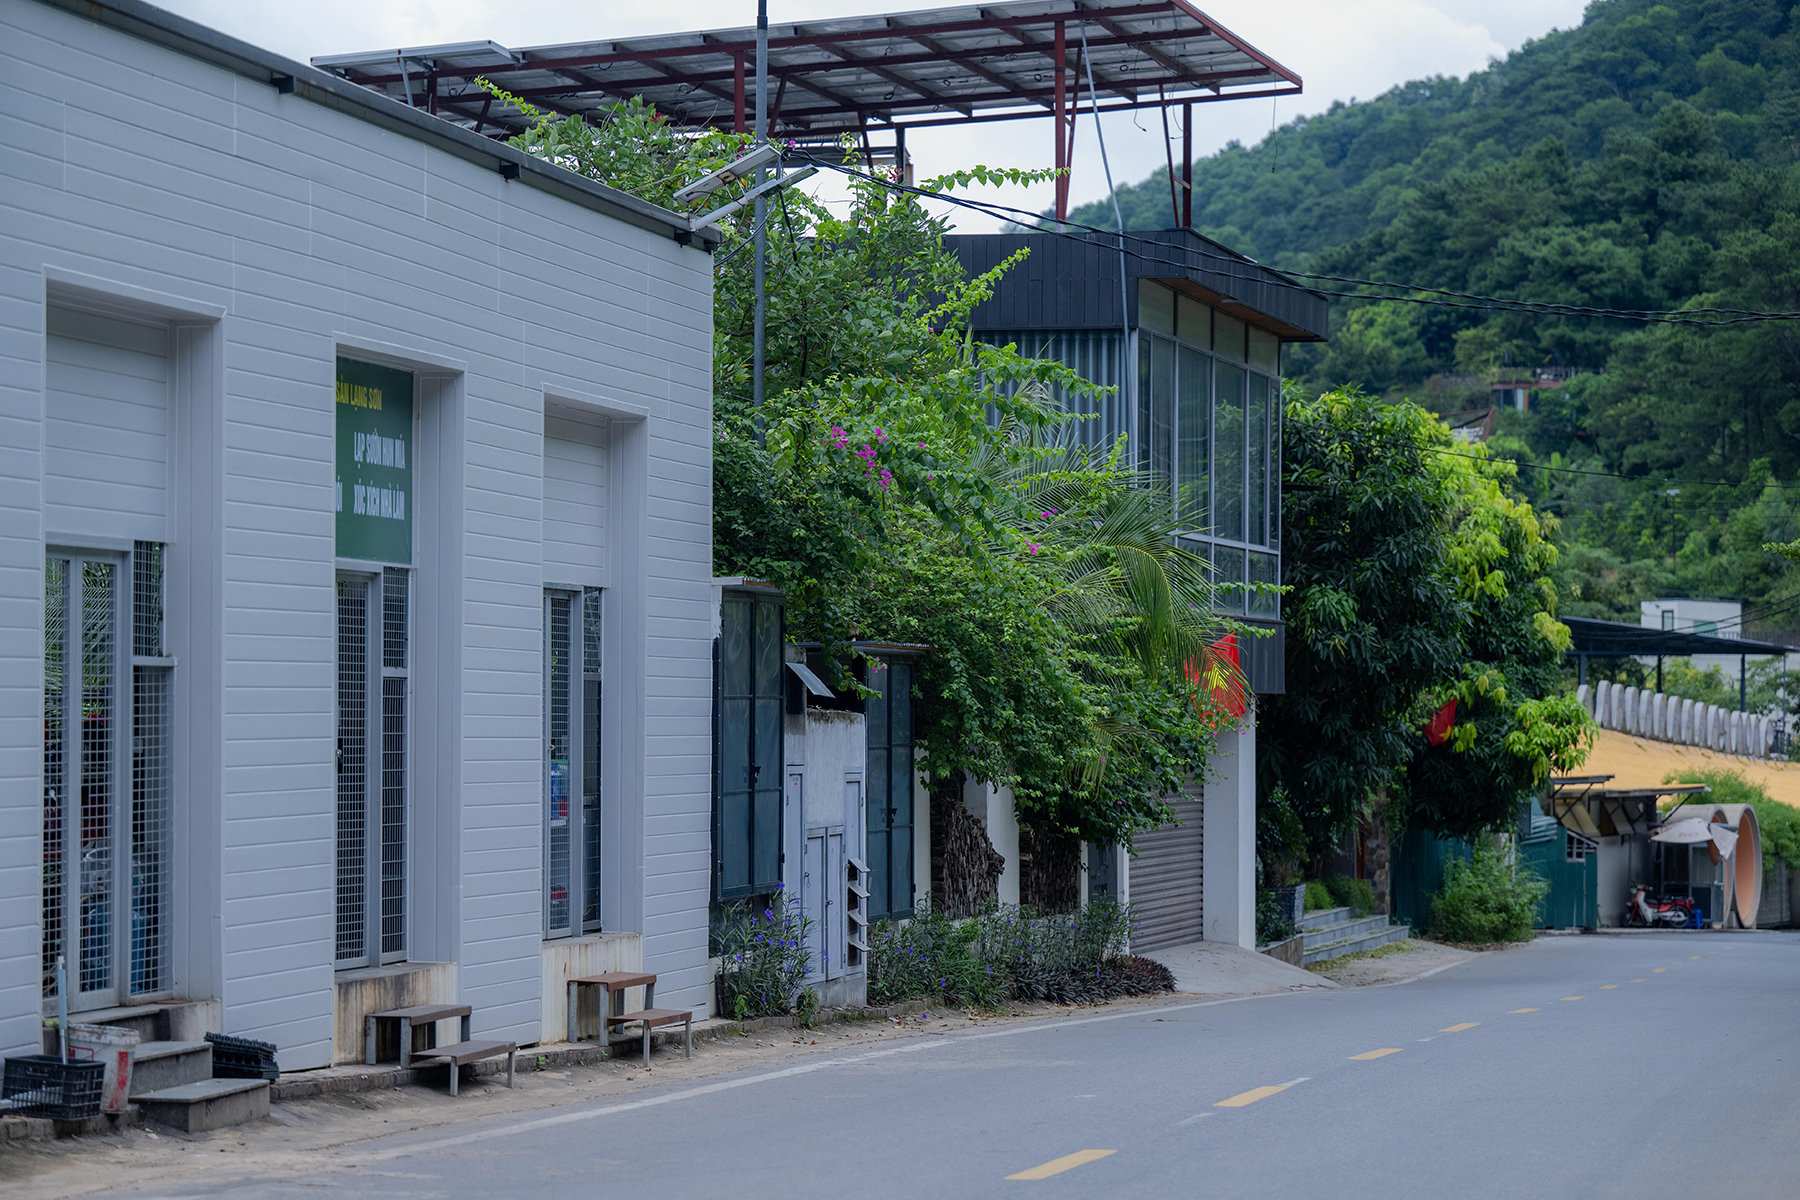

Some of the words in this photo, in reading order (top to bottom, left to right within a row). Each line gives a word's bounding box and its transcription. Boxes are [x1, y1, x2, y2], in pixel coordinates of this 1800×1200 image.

[350, 384, 367, 411] LẠNG
[368, 388, 382, 411] SƠN
[354, 431, 365, 469] LẠP
[353, 478, 365, 515] XÚC
[366, 480, 380, 517] XÍCH
[381, 483, 392, 518] NHÀ
[393, 484, 404, 520] LÀM
